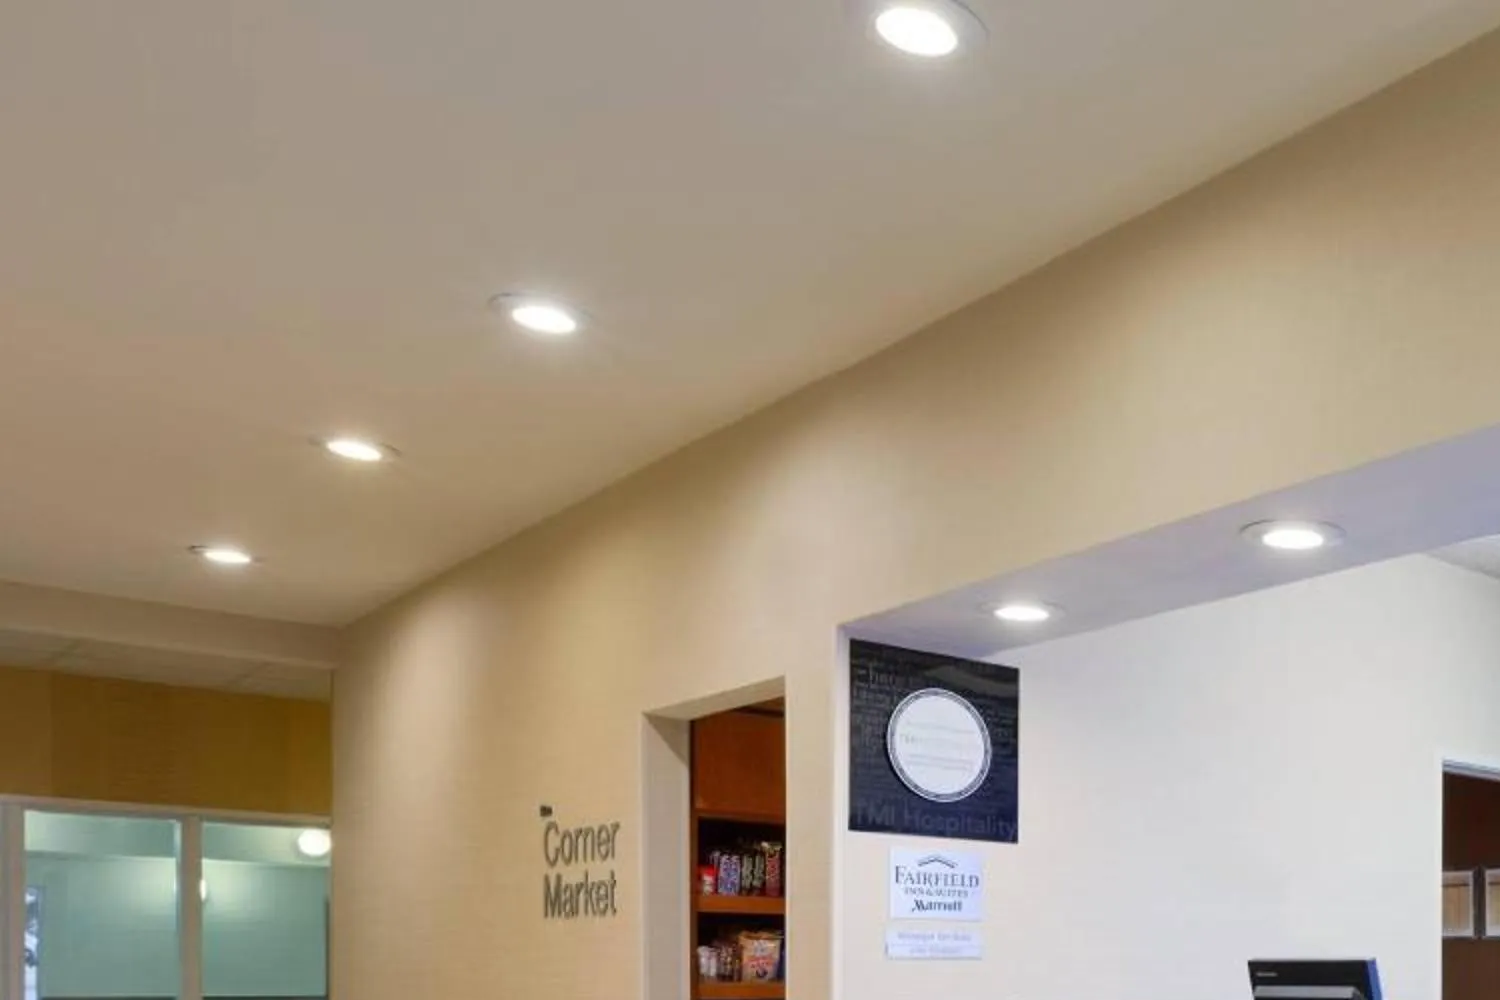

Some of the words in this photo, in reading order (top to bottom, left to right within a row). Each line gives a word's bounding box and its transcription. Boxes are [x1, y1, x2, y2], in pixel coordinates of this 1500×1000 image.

[856, 800, 896, 826] TMI
[904, 800, 1017, 841] Hospitality
[544, 820, 620, 868] Corner
[544, 869, 617, 919] Market
[895, 865, 980, 888] FAIRFIELD
[911, 899, 963, 912] Marriott
